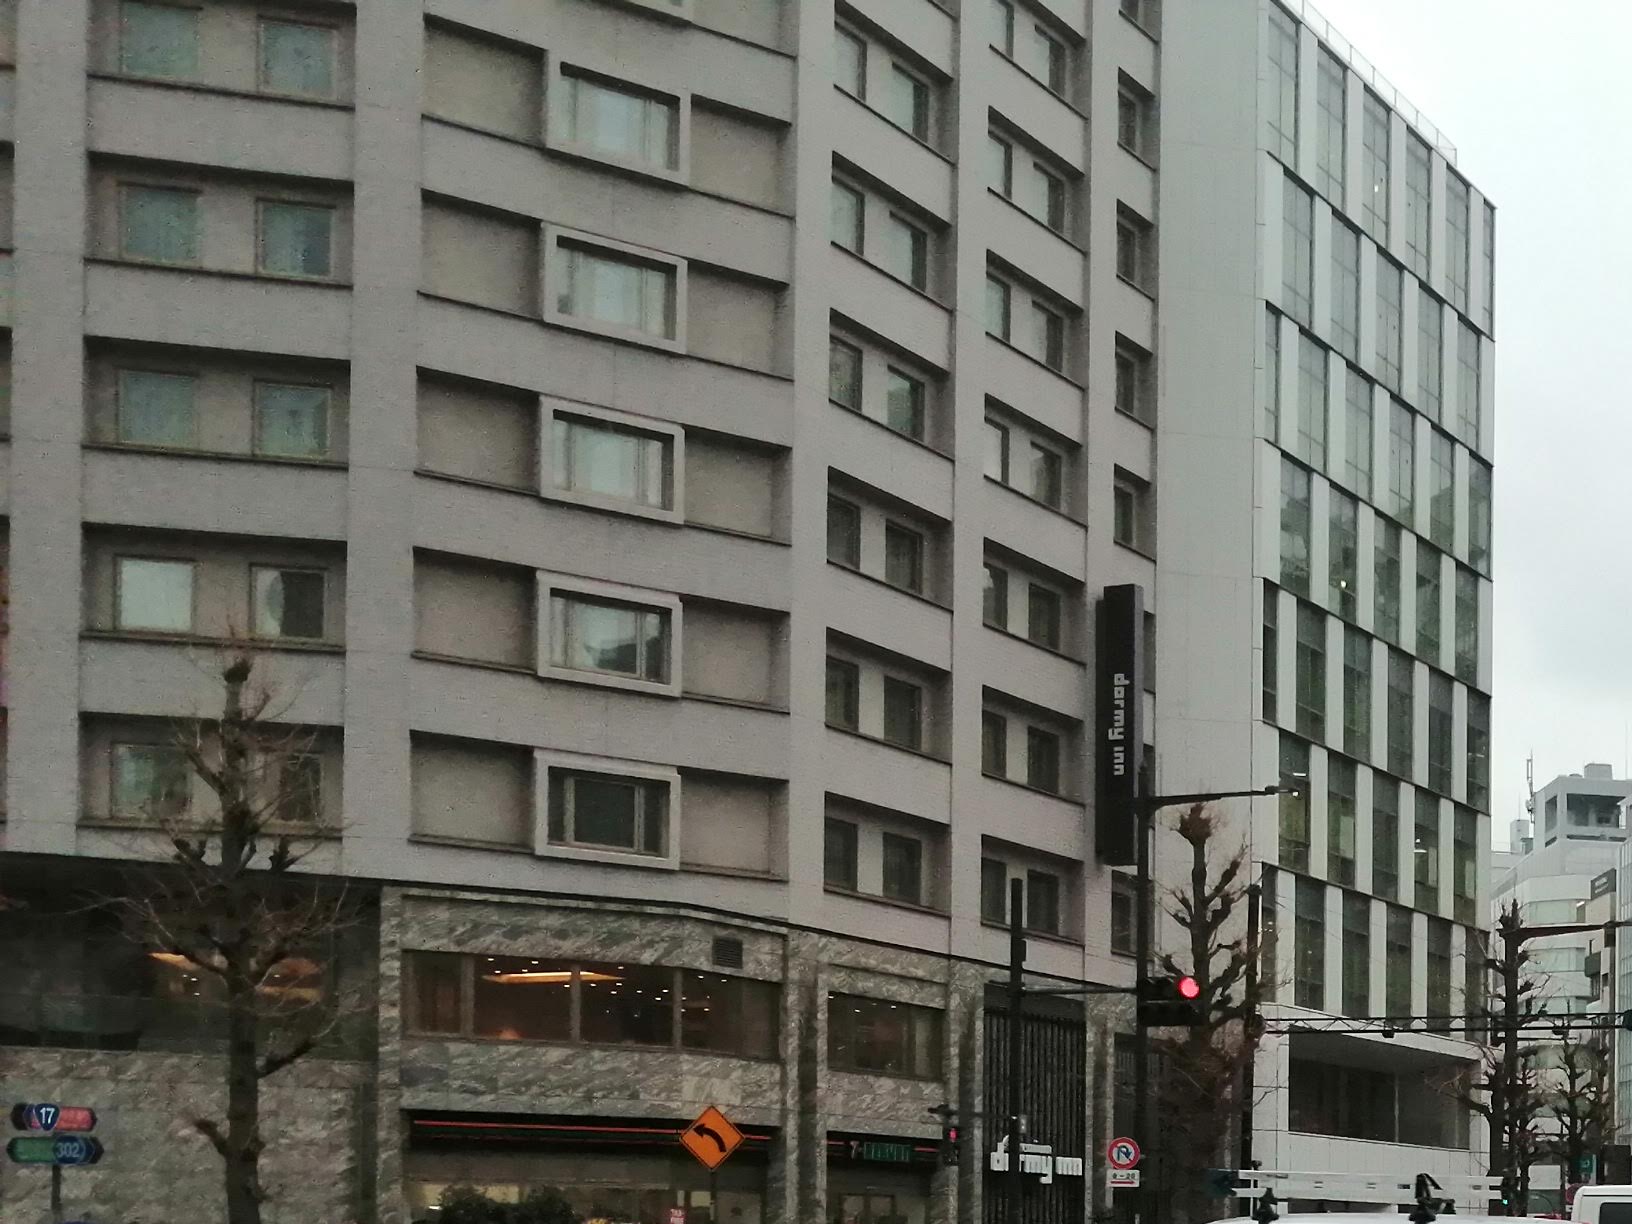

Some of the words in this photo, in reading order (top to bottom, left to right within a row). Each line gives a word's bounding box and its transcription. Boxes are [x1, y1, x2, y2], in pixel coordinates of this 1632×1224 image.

[1108, 673, 1130, 740] dormy
[1113, 746, 1125, 776] inn
[40, 1107, 56, 1125] 17
[55, 1142, 80, 1159] 302
